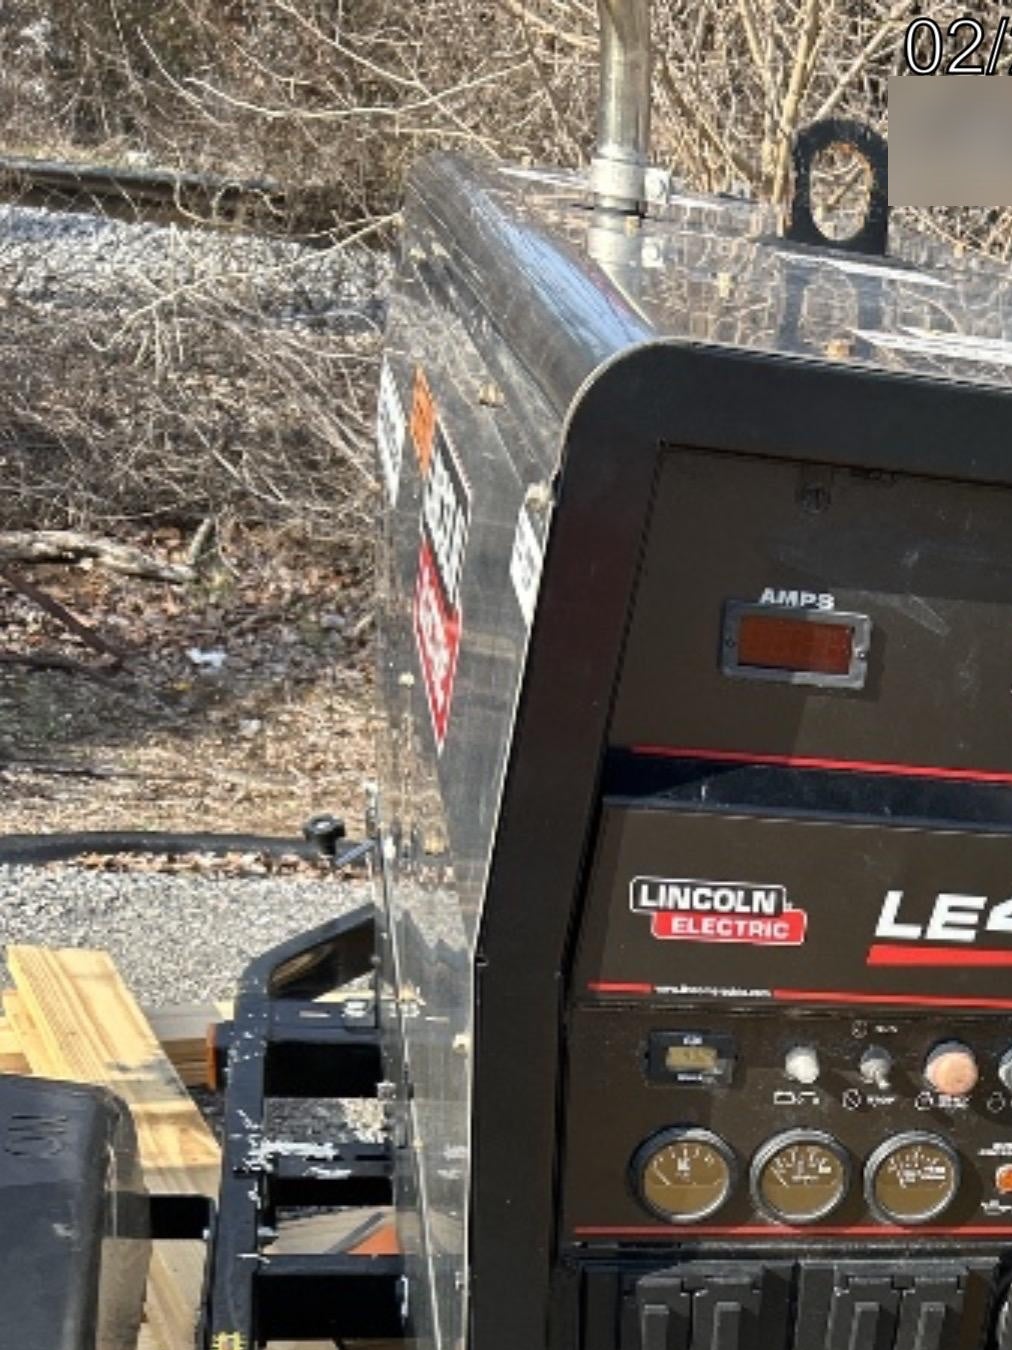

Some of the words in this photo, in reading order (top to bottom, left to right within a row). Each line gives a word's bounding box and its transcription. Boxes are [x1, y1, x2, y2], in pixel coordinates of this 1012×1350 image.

[759, 586, 835, 610] AMPS
[640, 884, 777, 915] LINCOLN
[671, 917, 790, 940] ELECTRIC
